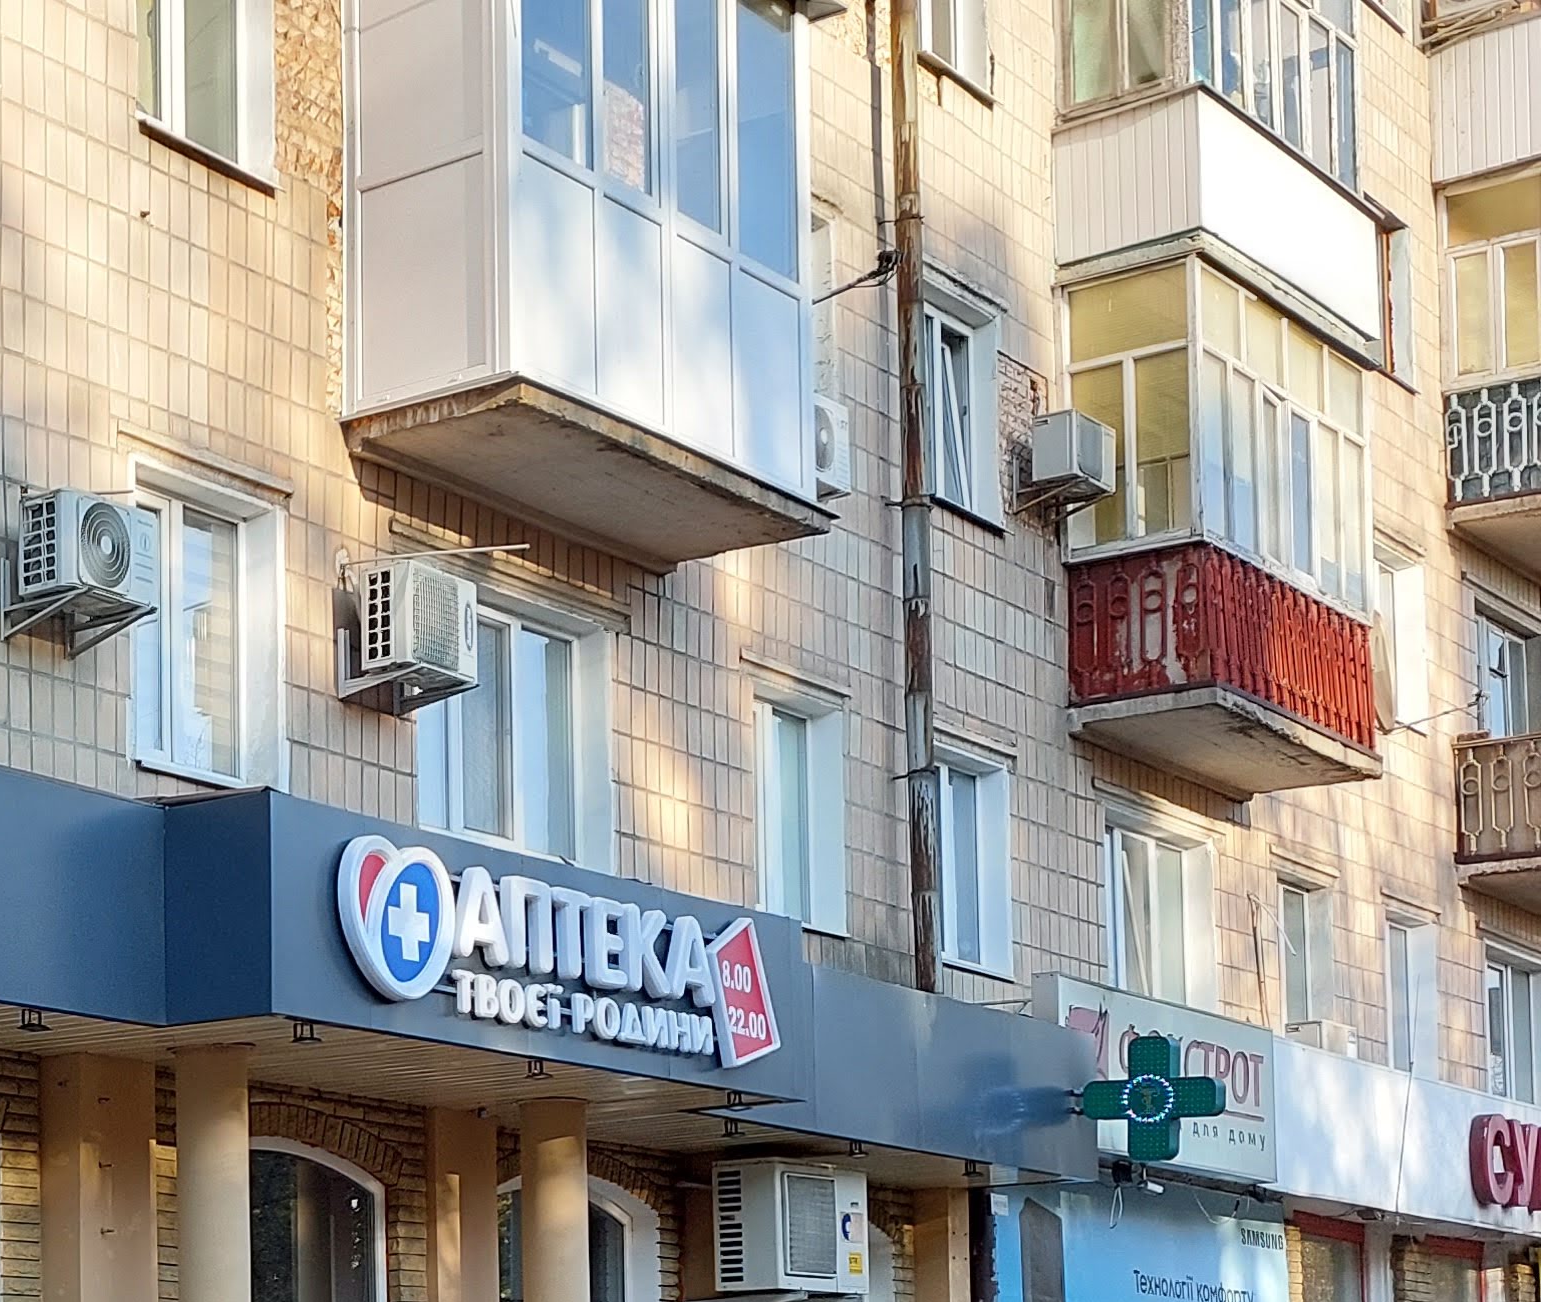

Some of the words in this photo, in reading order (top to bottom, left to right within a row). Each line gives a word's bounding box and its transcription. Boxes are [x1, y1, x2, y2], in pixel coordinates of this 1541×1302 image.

[453, 866, 715, 1007] АПТЕКА
[721, 960, 751, 993] 8.00
[452, 968, 562, 1030] ТВОЄЇ
[572, 992, 715, 1055] РОДИНИ
[728, 1005, 766, 1041] 22.00
[1192, 1121, 1219, 1138] для
[1229, 1129, 1266, 1151] дому
[1241, 1228, 1284, 1250] SAMSUNG
[1133, 1269, 1194, 1301] Технології
